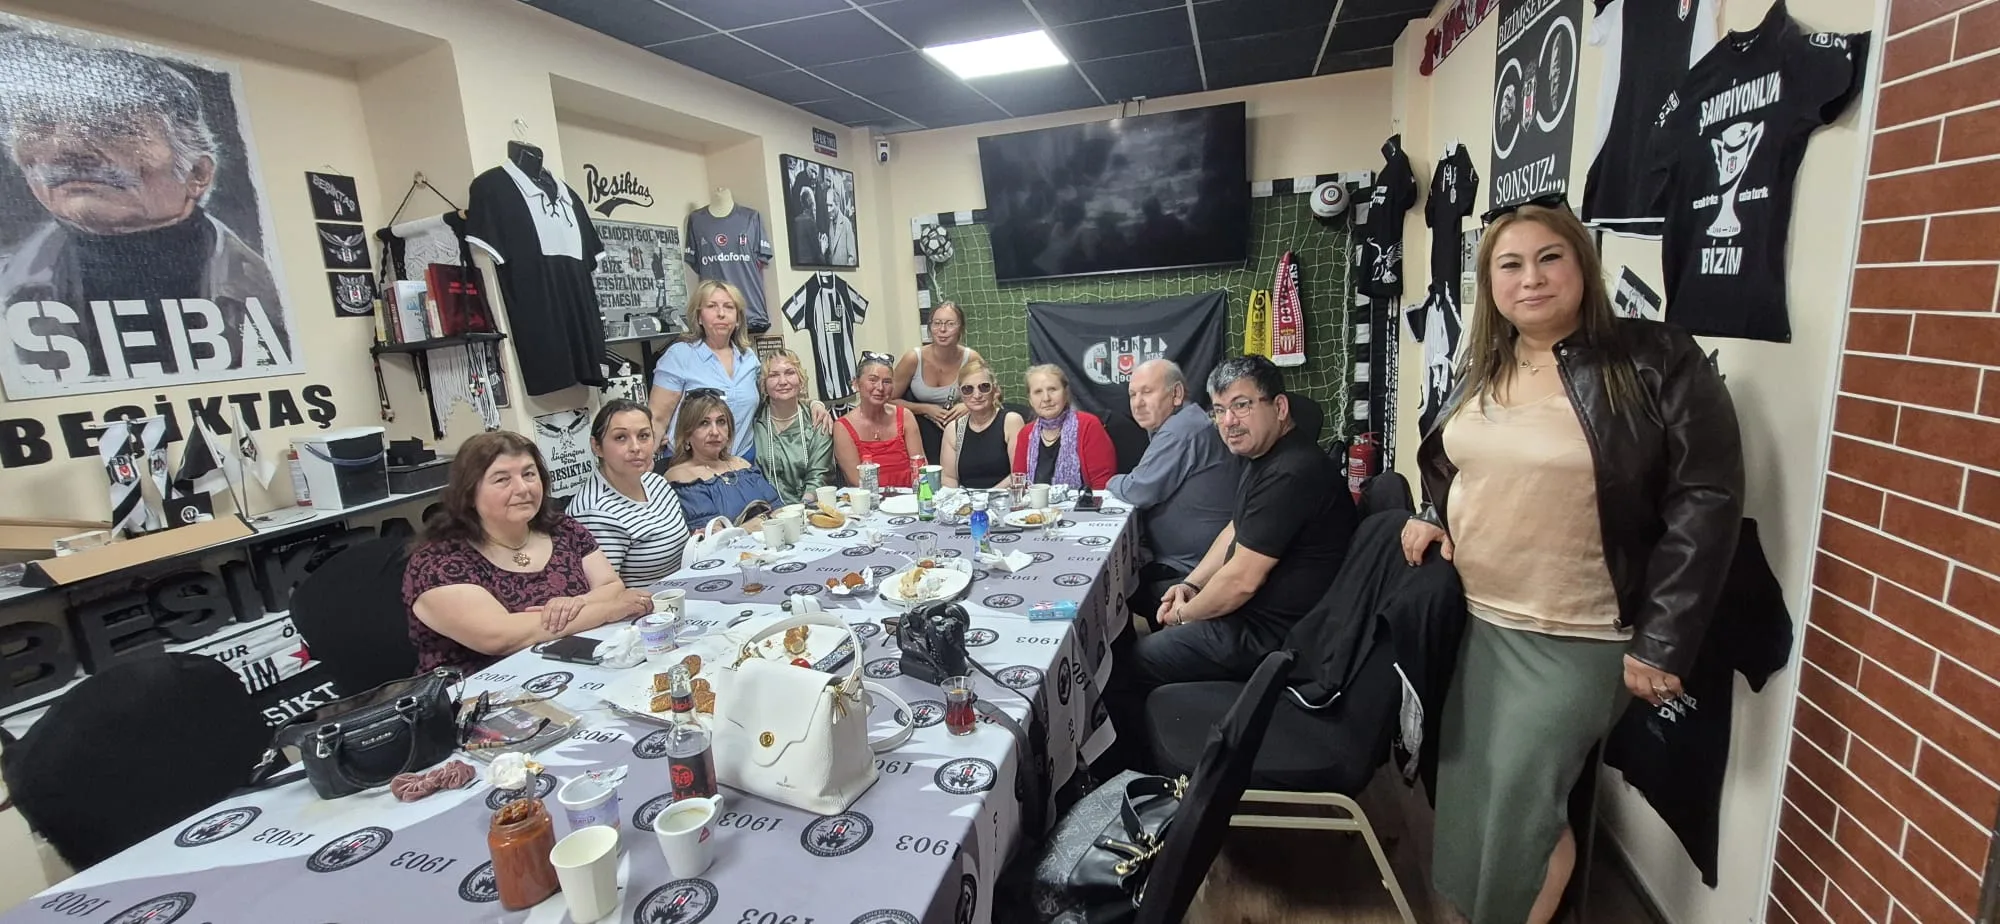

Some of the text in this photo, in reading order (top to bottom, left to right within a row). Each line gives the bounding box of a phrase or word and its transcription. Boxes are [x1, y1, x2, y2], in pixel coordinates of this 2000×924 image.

[1701, 238, 1743, 275] BİZİM
[601, 257, 624, 274] BİZE
[3, 297, 293, 384] SEBA
[1111, 340, 1139, 352] BJK
[1114, 374, 1132, 383] 190
[1016, 635, 1060, 645] 1903
[579, 682, 605, 691] 03
[572, 729, 625, 744] 1903
[876, 760, 915, 775] 190
[719, 811, 784, 832] 1903
[252, 827, 316, 847] 1903
[895, 834, 962, 861] 1903
[390, 851, 457, 875] 1903
[41, 891, 111, 917] 1903
[736, 908, 815, 924] 903
